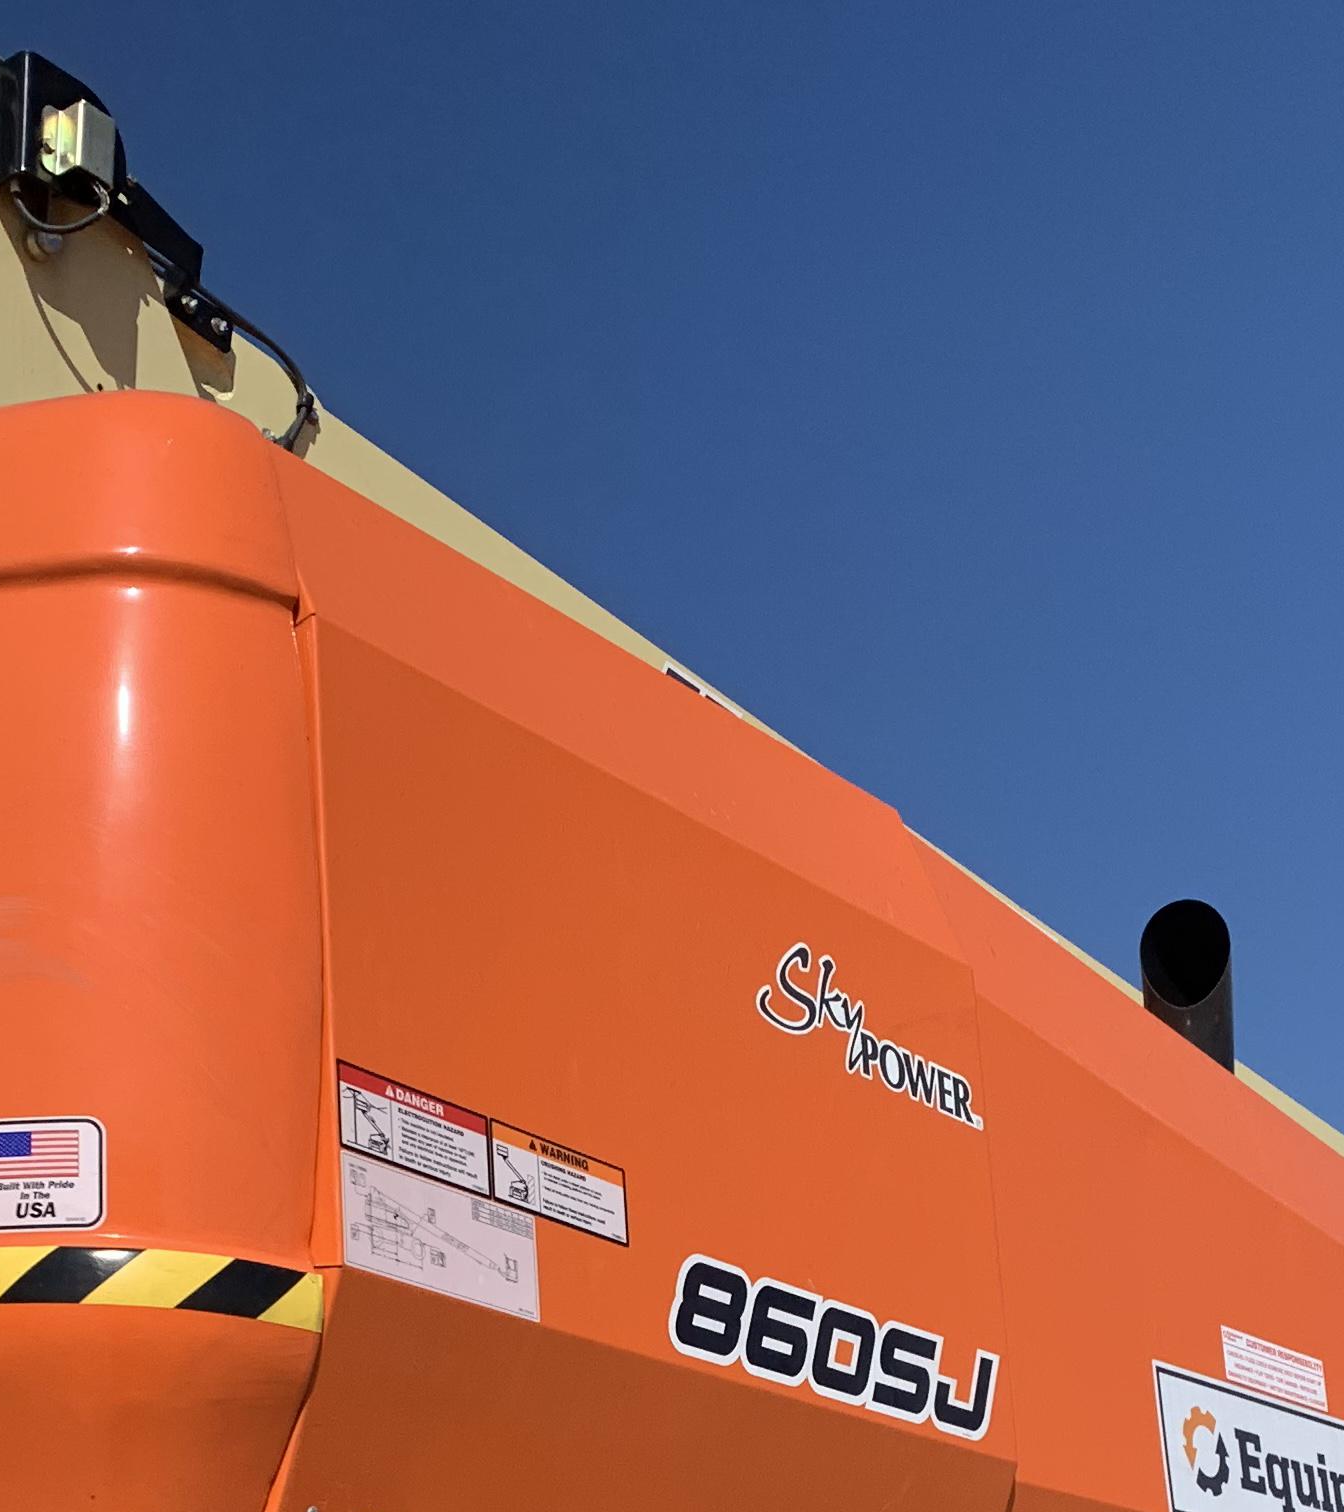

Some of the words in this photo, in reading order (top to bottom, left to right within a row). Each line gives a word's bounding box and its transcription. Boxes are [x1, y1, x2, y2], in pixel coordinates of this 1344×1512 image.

[758, 945, 865, 1073] Sky
[859, 1031, 975, 1125] POWER
[395, 1087, 445, 1118] DANGER
[539, 1142, 589, 1172] WARNING
[20, 1191, 30, 1200] In
[33, 1190, 51, 1200] The
[23, 1180, 45, 1190] With
[48, 1179, 75, 1190] Pride
[16, 1201, 57, 1219] USA
[674, 1260, 996, 1434] 860SJ
